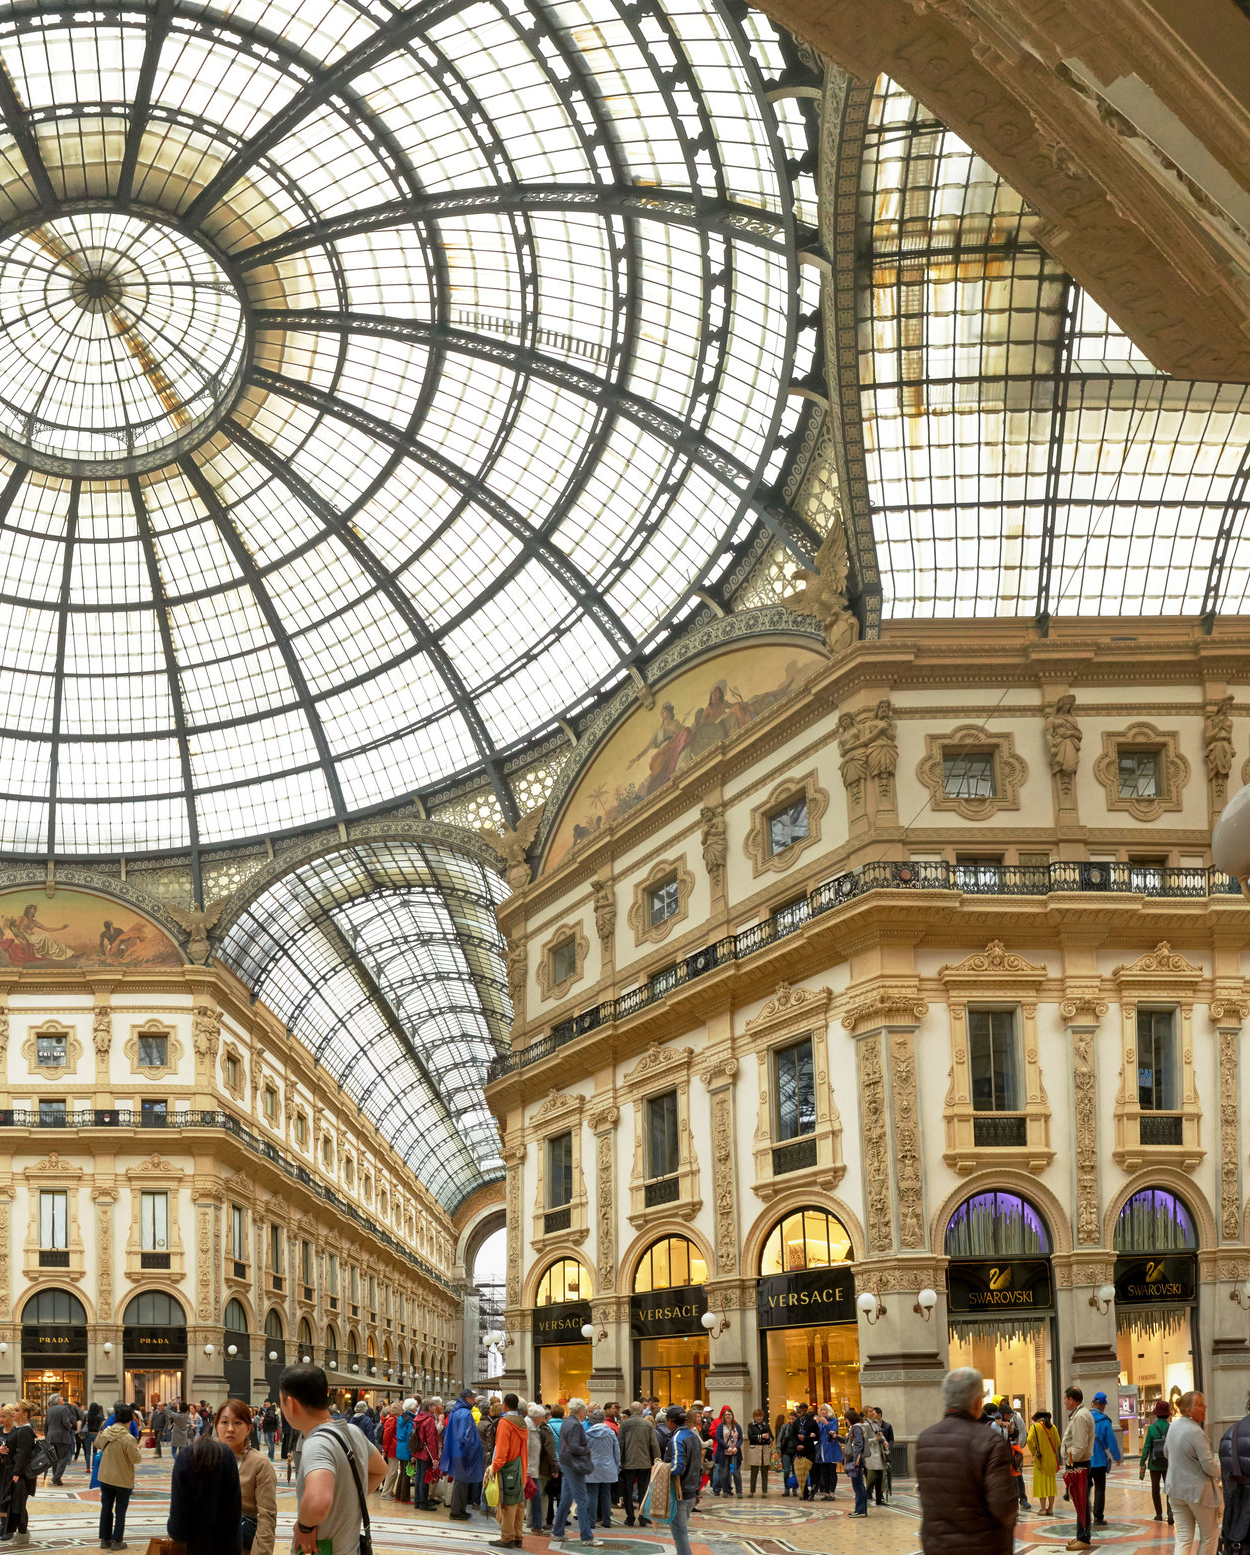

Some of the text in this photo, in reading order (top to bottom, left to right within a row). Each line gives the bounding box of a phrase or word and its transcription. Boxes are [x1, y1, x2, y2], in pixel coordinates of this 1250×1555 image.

[768, 1287, 844, 1308] VERSACE
[969, 1290, 1033, 1305] SWAROVSKI
[1127, 1283, 1182, 1297] SWAROVSKI
[639, 1304, 699, 1321] VERSACE
